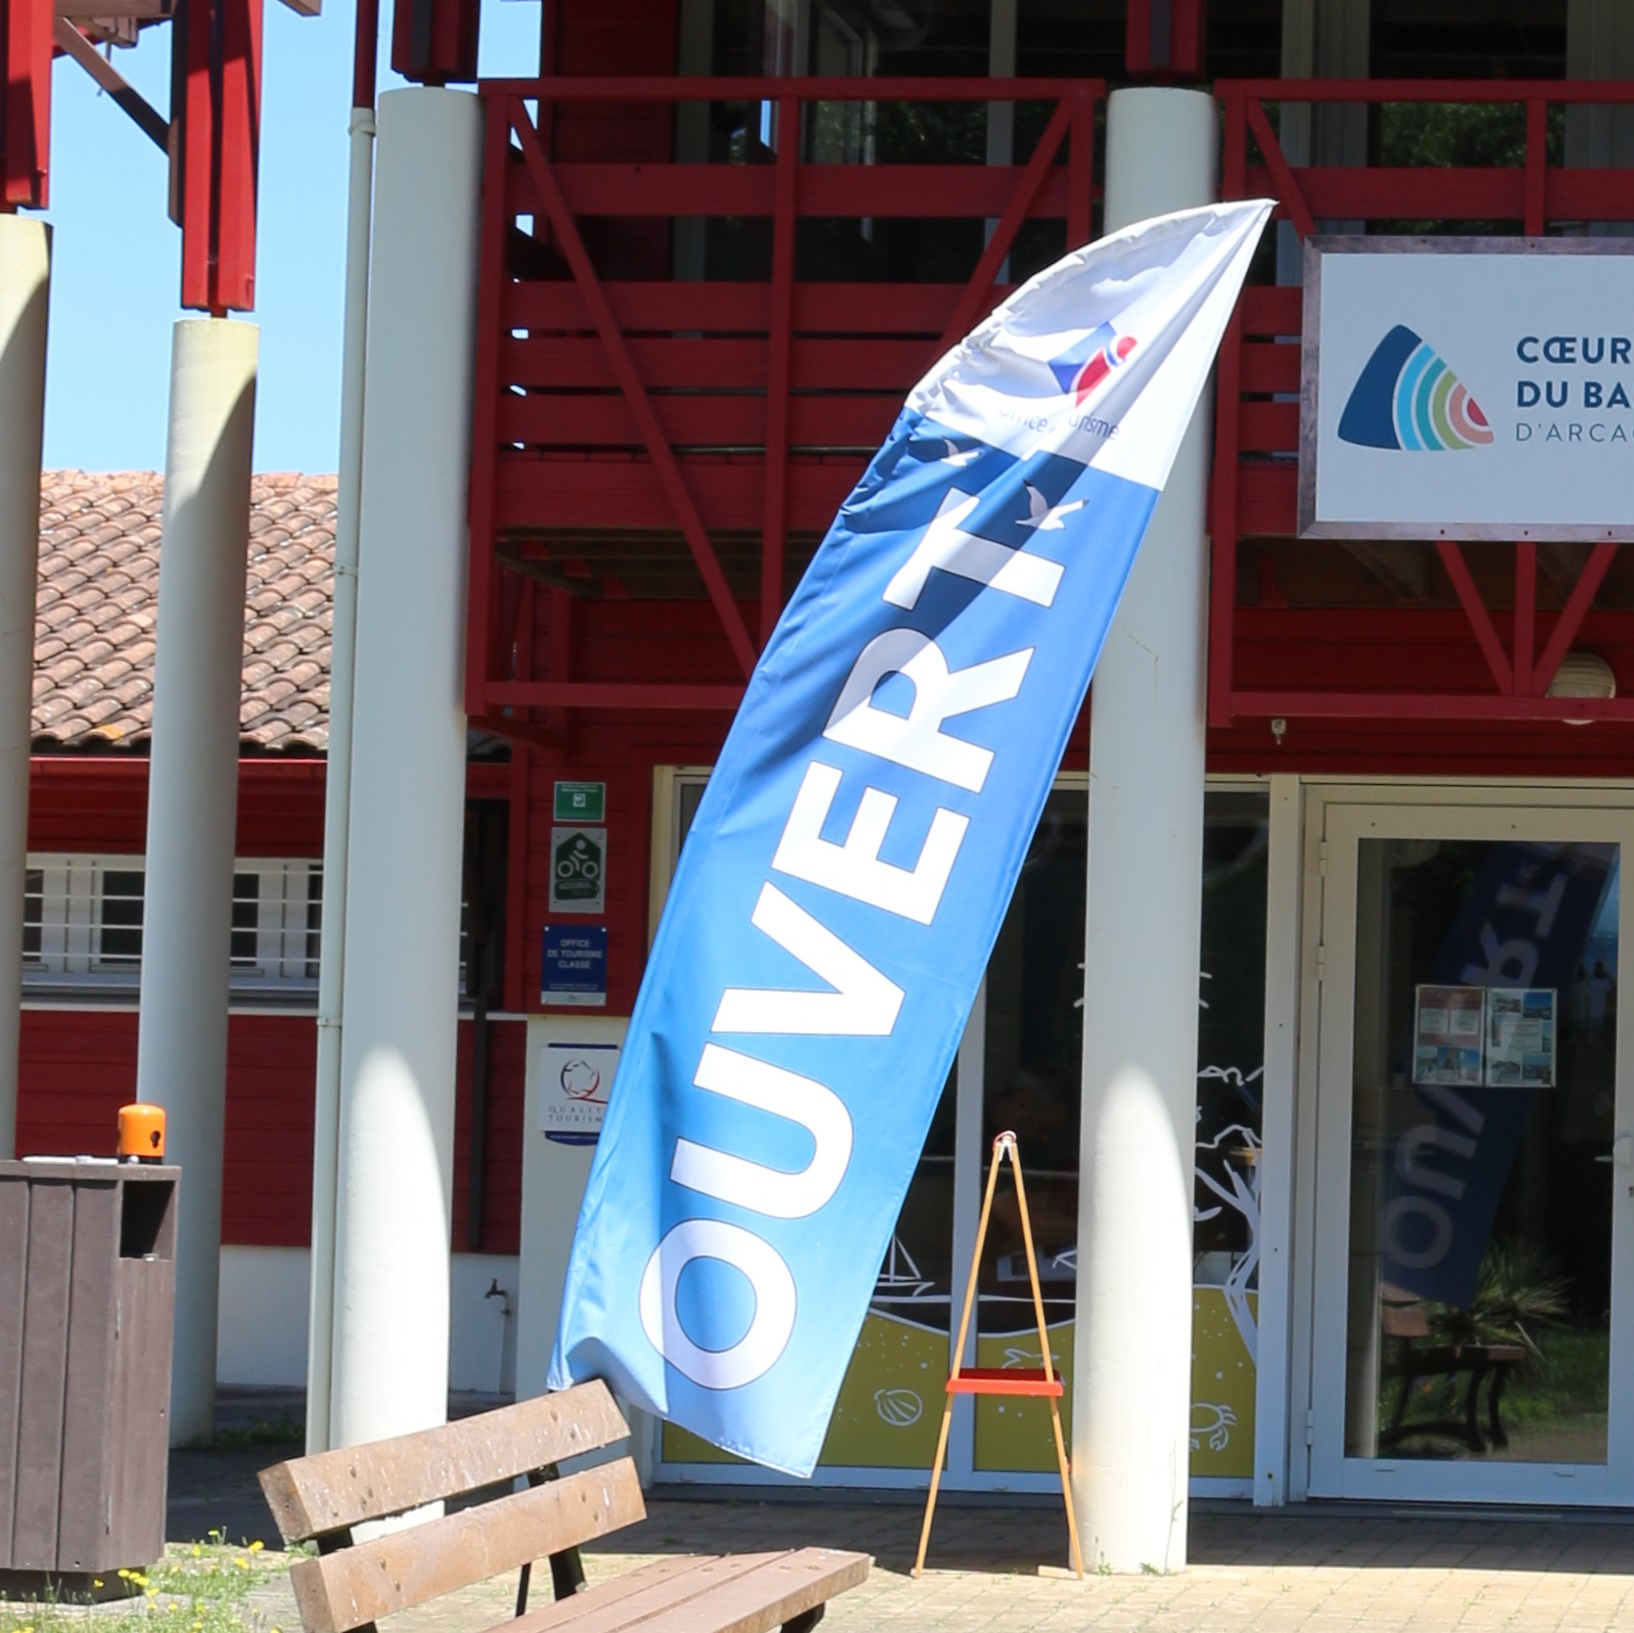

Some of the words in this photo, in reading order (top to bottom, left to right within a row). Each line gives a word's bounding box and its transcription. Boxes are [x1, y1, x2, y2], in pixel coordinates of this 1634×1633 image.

[1515, 336, 1632, 365] CŒUR
[1516, 380, 1570, 409] DU
[560, 939, 590, 948] OFFICE
[638, 487, 1067, 1390] OUVERT
[547, 949, 559, 958] DE
[561, 949, 603, 959] TOURISME
[548, 1106, 603, 1114] QUALIT
